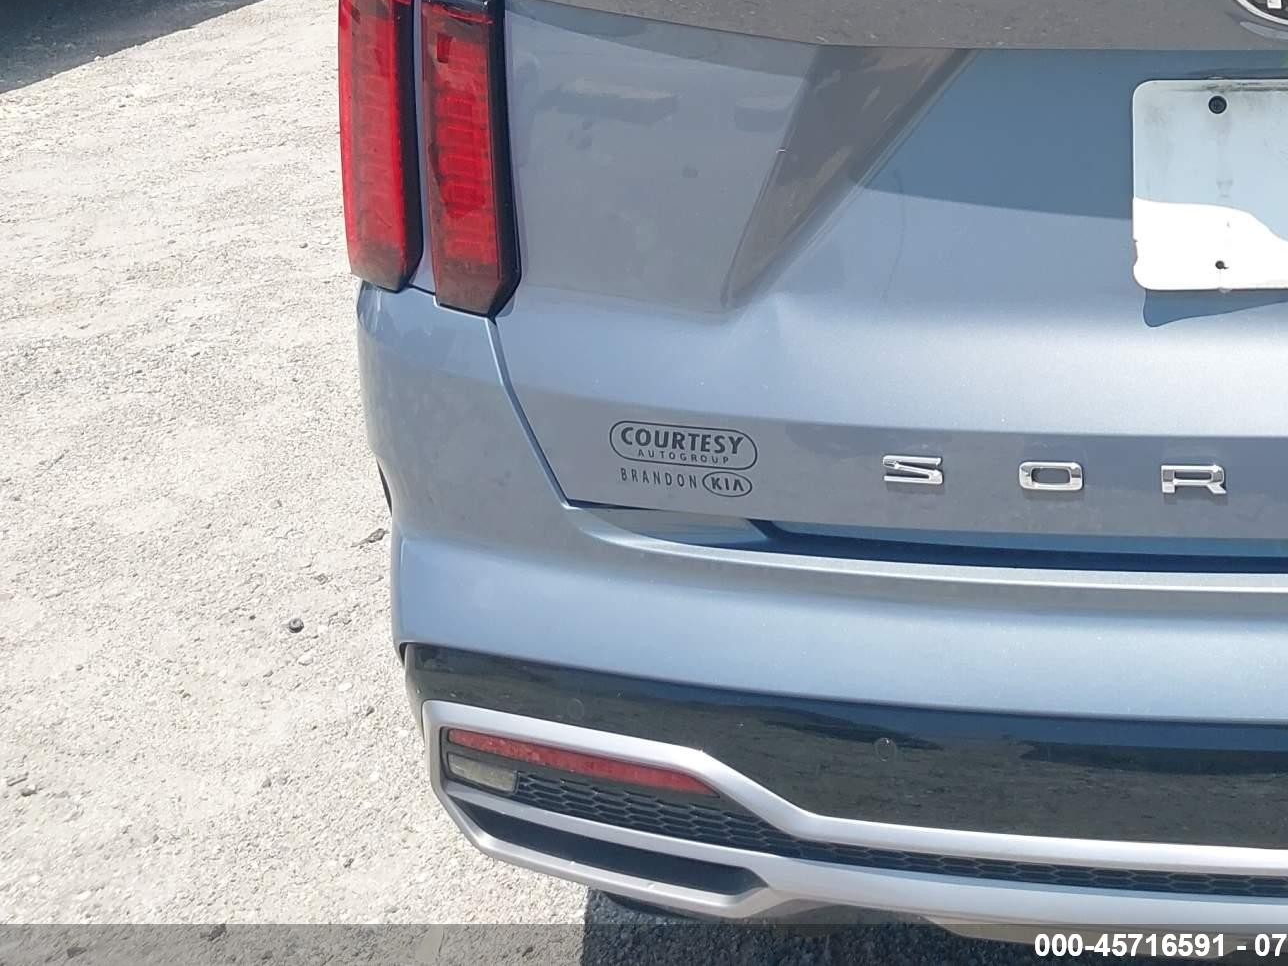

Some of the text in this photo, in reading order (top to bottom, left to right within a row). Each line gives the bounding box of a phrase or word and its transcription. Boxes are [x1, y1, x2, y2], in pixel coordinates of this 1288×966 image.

[620, 426, 744, 454] COURTESY
[638, 449, 729, 464] AUTOGROUP
[620, 467, 697, 489] BRANDON
